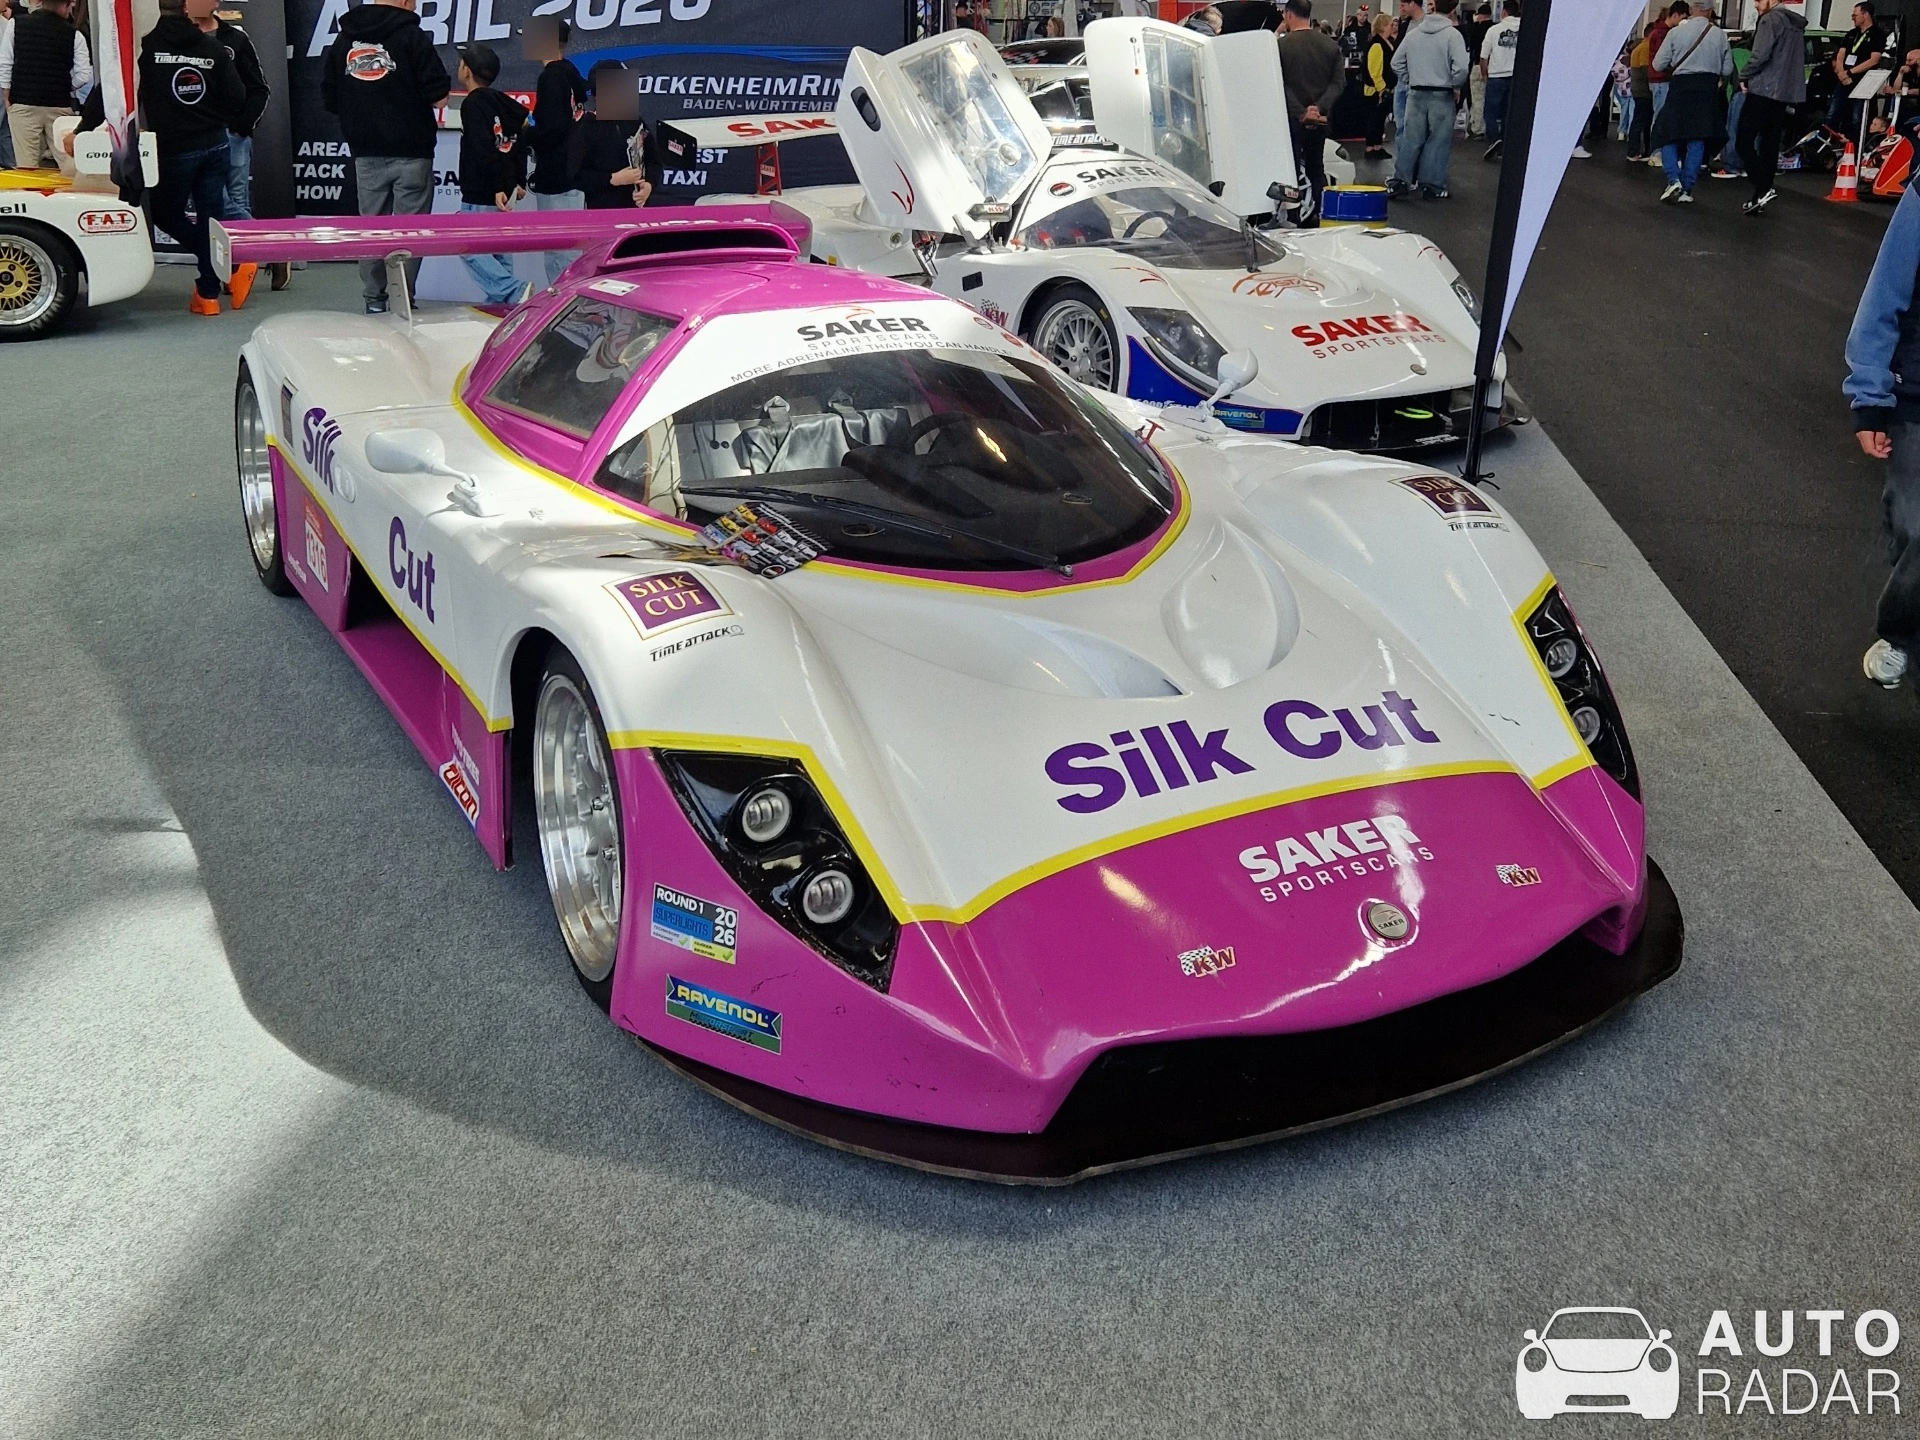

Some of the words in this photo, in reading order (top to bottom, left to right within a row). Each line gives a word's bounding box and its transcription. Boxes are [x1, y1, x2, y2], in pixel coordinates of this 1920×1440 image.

[306, 0, 510, 57] ARIL
[298, 141, 351, 157] AREA
[663, 170, 707, 185] TAXI
[797, 316, 932, 342] SAKER
[807, 332, 940, 351] SPORTSCARS
[1291, 314, 1434, 347] SAKER
[1312, 334, 1447, 359] SPORTSCARS
[730, 363, 774, 383] MORE
[777, 344, 863, 368] ADRENALINE
[867, 340, 903, 351] THAN
[905, 341, 933, 349] YOU
[936, 340, 962, 349] CAN
[302, 407, 344, 496] Silk
[388, 515, 436, 625] Cut
[629, 574, 696, 599] SILK
[643, 588, 706, 617] CUT
[1044, 720, 1257, 814] Silk
[1263, 690, 1441, 760] Cut
[1238, 815, 1421, 883] SAKER
[1260, 847, 1435, 903] SPORTSCARS
[1508, 866, 1541, 886] KW
[656, 886, 697, 912] ROUND
[714, 906, 737, 928] 20
[1378, 919, 1404, 930] SAKER
[713, 925, 735, 947] 26
[1192, 947, 1235, 976] KW
[677, 984, 769, 1028] RAVENOL
